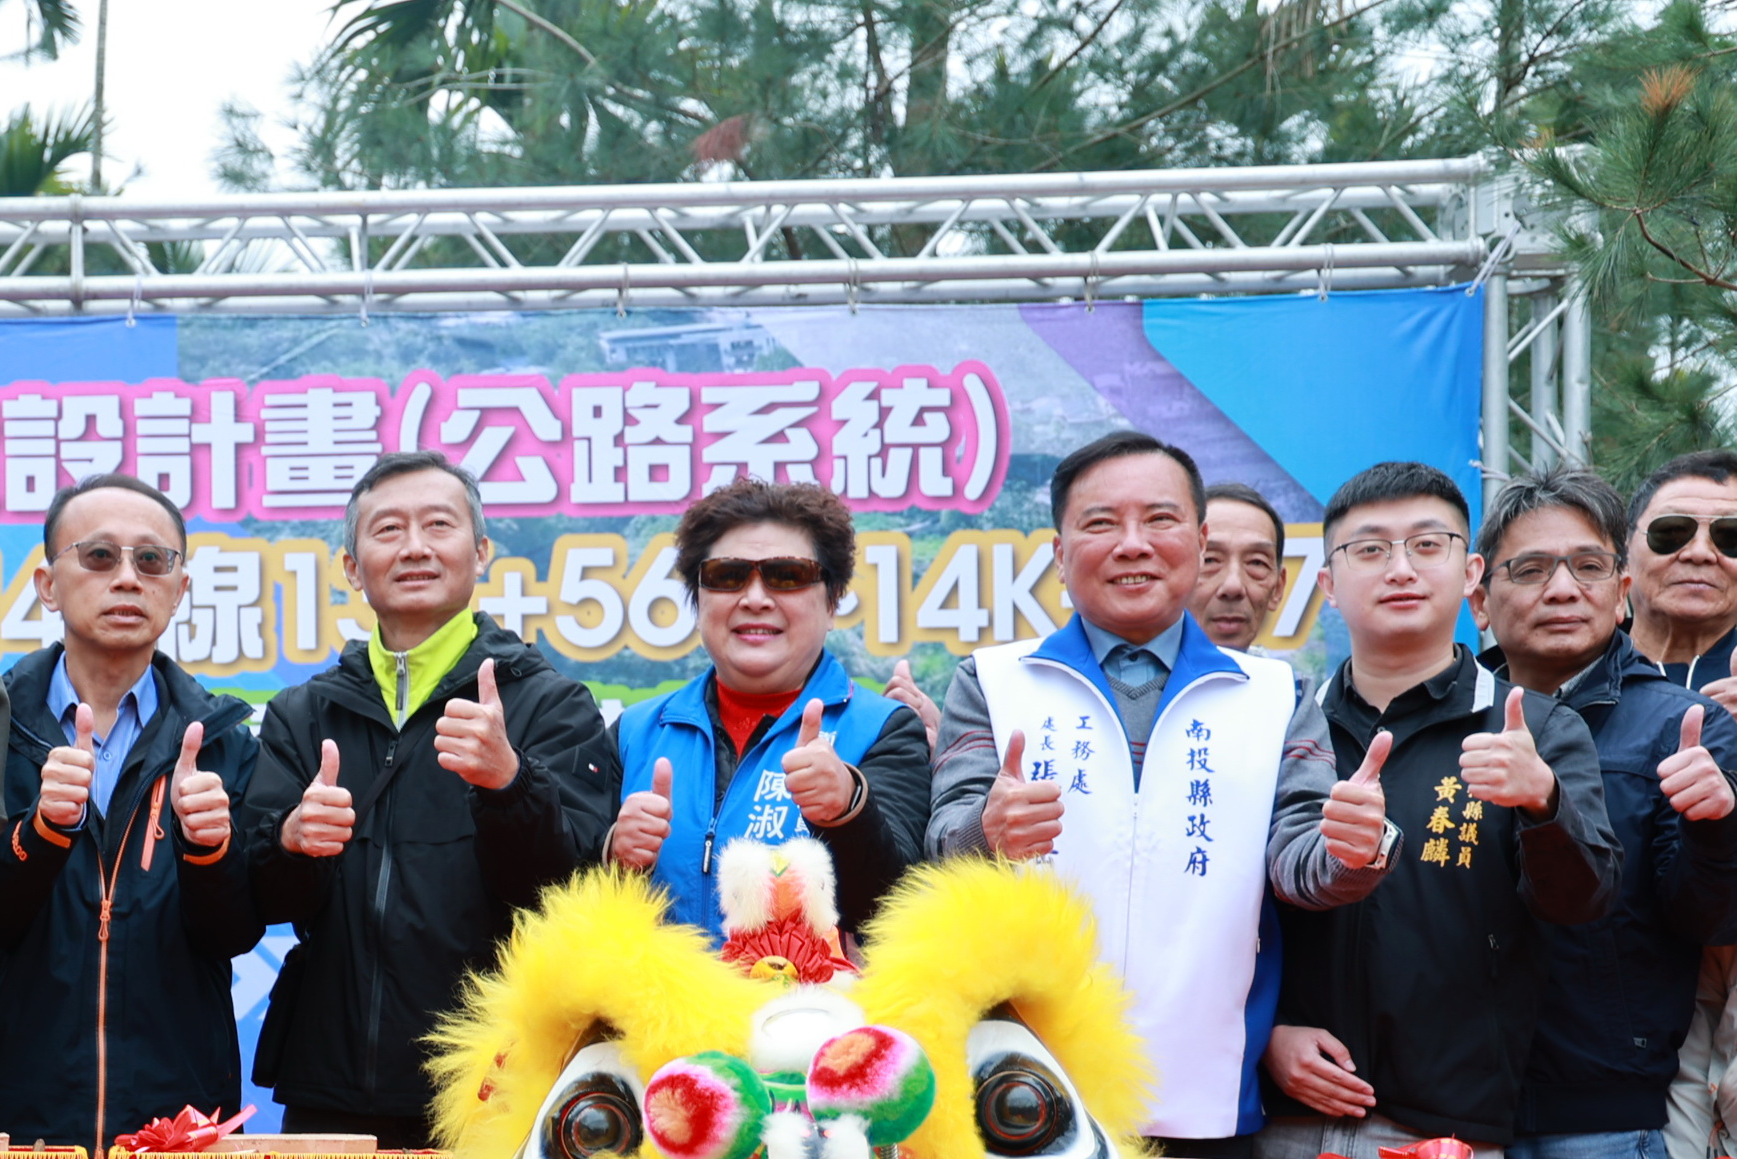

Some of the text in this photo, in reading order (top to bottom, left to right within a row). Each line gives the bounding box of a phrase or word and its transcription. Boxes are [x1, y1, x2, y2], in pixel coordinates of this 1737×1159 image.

[1066, 715, 1096, 795] 工務處
[1183, 717, 1216, 878] 南投縣政府
[1420, 775, 1463, 868] 黃春麟
[1455, 789, 1483, 869] 縣議員
